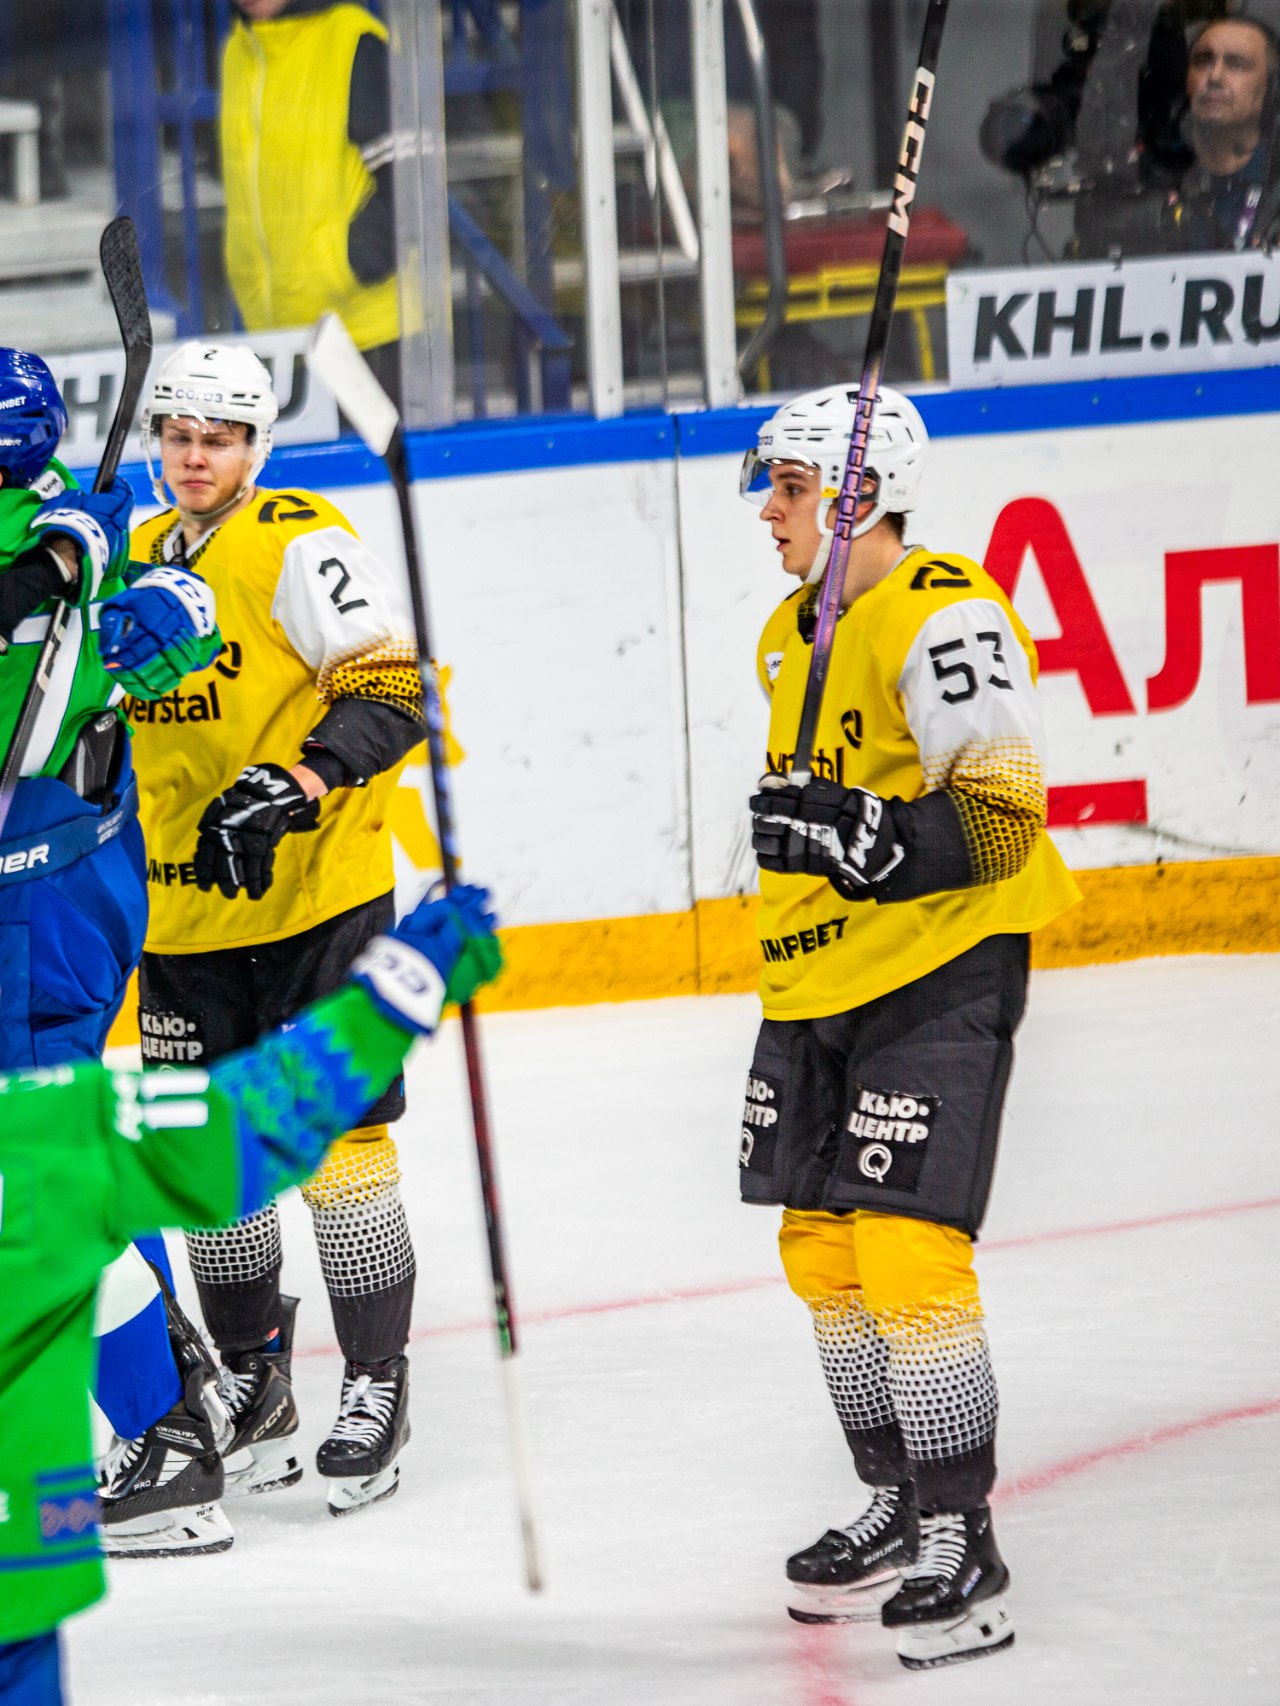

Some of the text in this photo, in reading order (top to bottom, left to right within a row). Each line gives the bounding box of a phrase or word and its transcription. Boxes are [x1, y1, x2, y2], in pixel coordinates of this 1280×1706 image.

[887, 66, 935, 237] CCM
[973, 272, 1280, 365] KHL.RU
[204, 349, 218, 361] 2
[319, 556, 369, 615] 2
[928, 630, 1014, 705] 53
[141, 1034, 204, 1061] ЦЕНТР
[847, 1111, 929, 1144] ЦЕНТР
[252, 1395, 289, 1441] CCM
[133, 1479, 152, 1491] PRO
